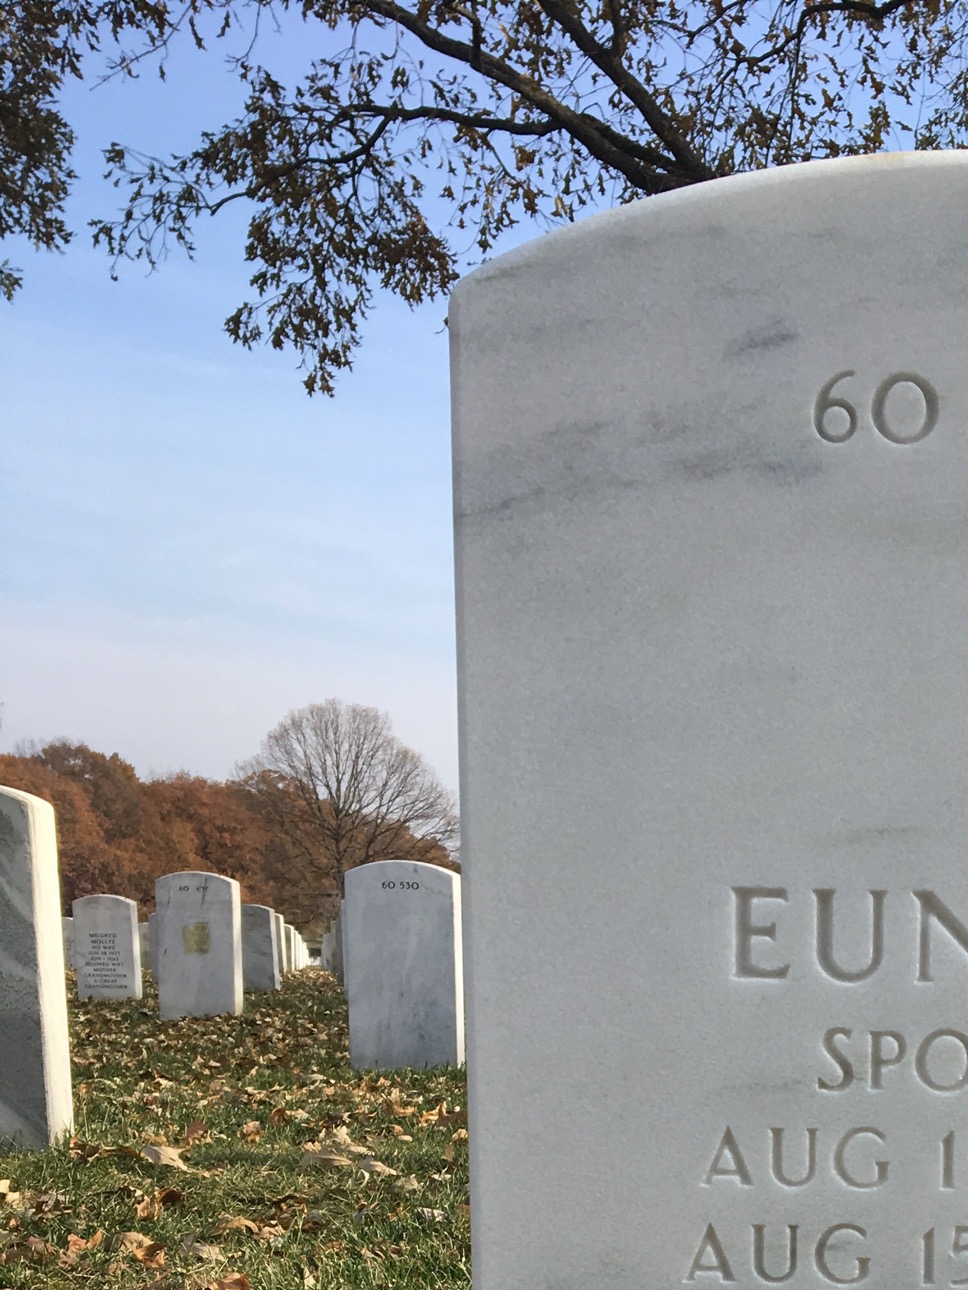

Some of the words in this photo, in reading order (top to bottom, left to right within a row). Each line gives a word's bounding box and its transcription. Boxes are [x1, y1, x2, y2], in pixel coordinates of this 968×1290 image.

[813, 369, 939, 444] 60
[382, 881, 396, 889] 60
[400, 881, 419, 890] 530
[701, 1126, 891, 1190] AUG
[684, 1222, 871, 1286] AUG
